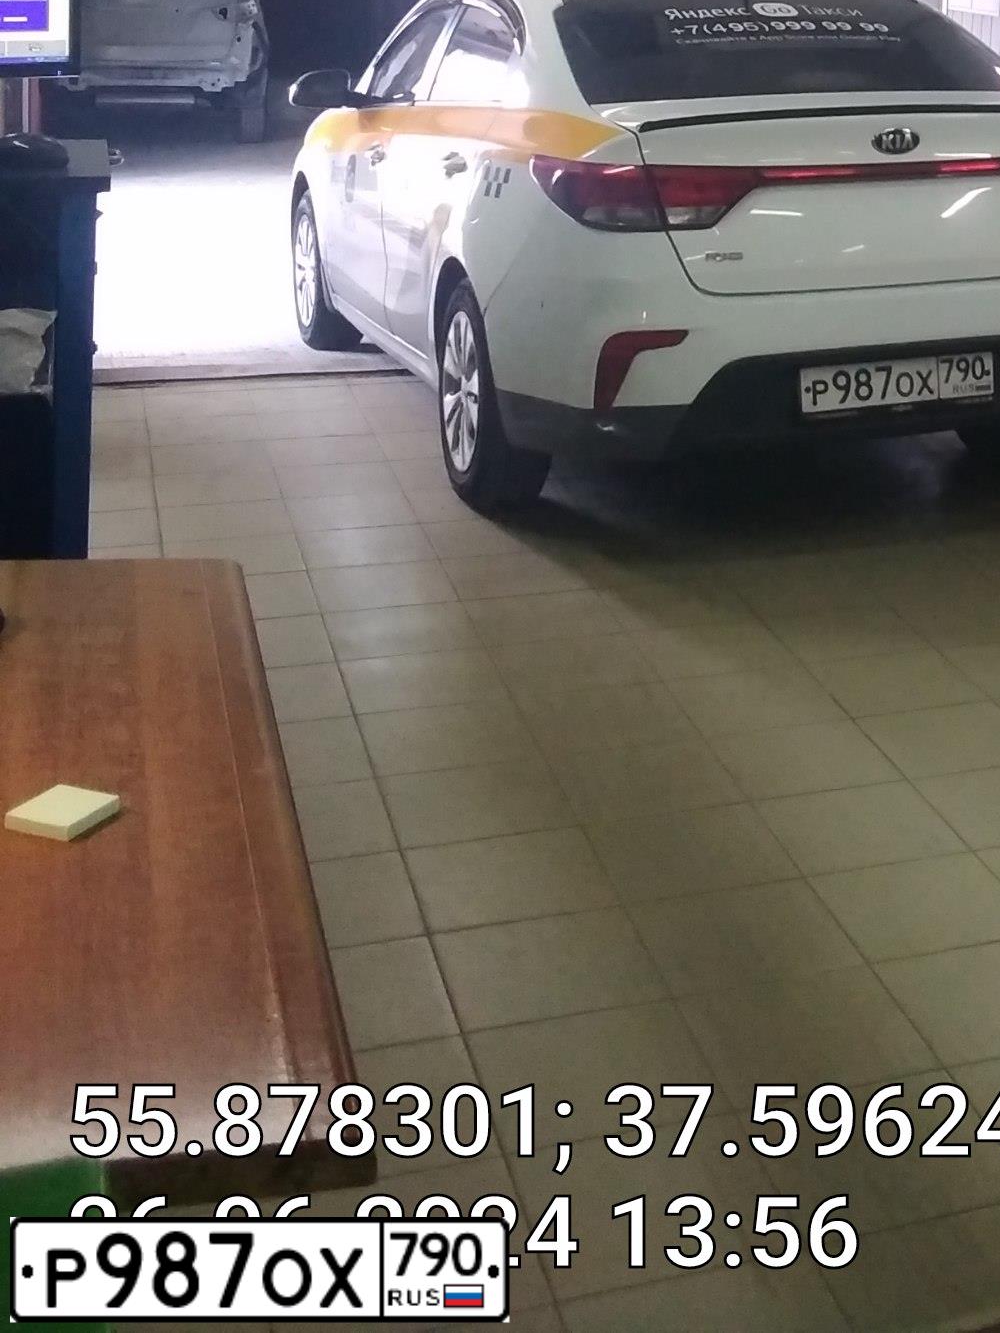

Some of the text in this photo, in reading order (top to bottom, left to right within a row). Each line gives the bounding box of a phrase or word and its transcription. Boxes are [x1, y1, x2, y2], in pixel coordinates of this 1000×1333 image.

[664, 7, 751, 20] Яндекс
[798, 5, 863, 17] Такси
[821, 21, 852, 31] 99
[859, 22, 889, 32] 99
[940, 354, 985, 384] 790
